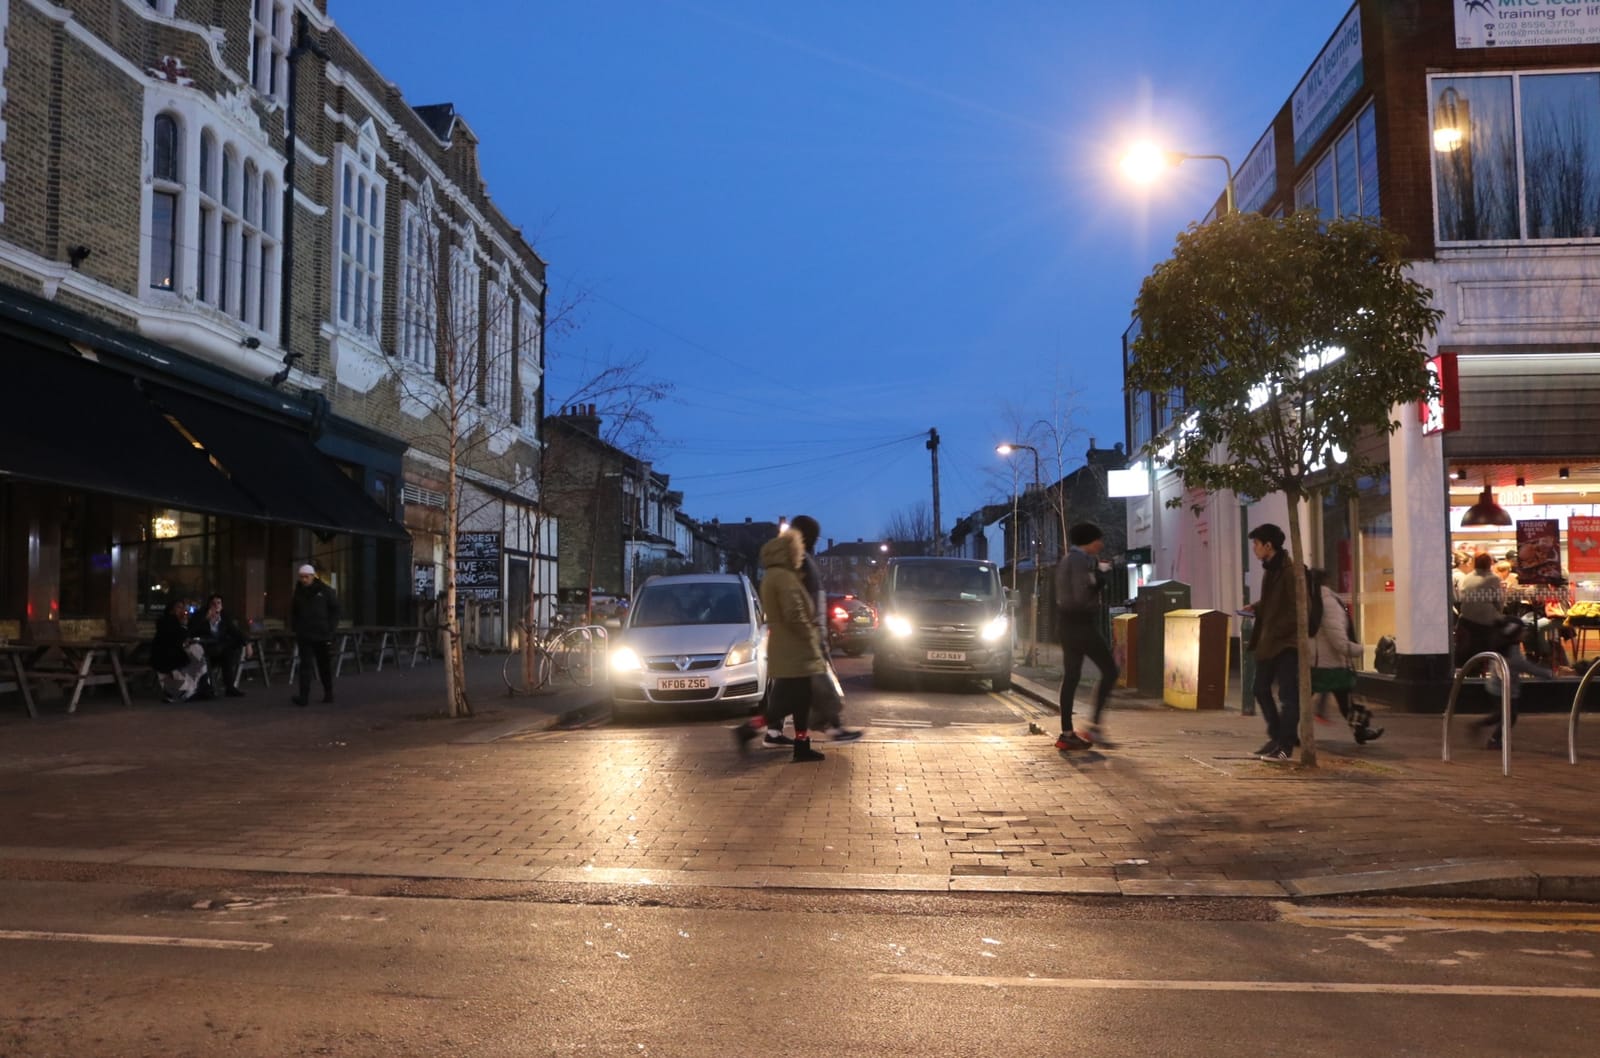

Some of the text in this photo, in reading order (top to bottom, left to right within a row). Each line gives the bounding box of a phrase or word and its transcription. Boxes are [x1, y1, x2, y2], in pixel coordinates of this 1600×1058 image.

[1499, 5, 1600, 20] training for lif
[1498, 22, 1517, 30] 020
[1324, 21, 1359, 74] learning
[458, 534, 498, 542] ARGEST
[661, 678, 706, 689] KF06 ZSG
